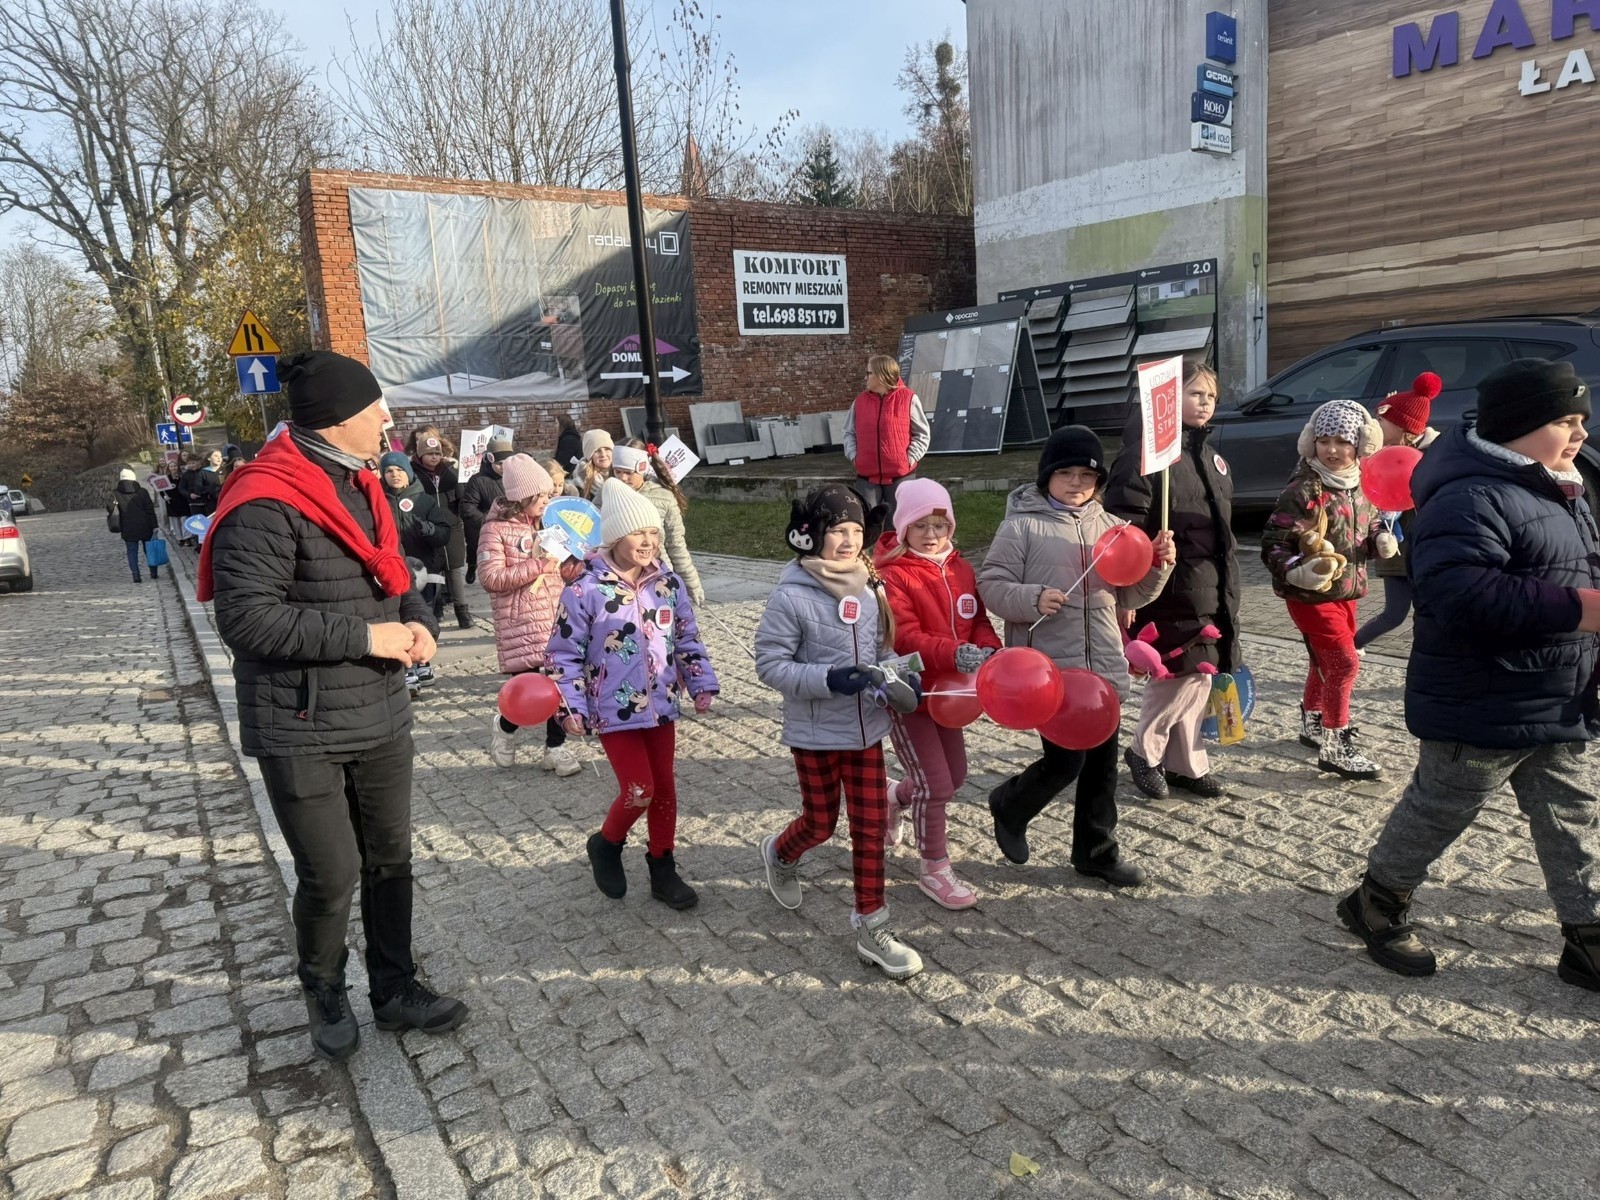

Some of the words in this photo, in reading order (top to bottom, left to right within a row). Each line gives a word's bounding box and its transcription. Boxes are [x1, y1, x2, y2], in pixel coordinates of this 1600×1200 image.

[1206, 70, 1232, 85] GERDA
[1518, 48, 1596, 96] ŁA
[1204, 99, 1225, 115] KOŁO
[744, 256, 841, 276] KOMFORT
[1193, 262, 1211, 275] 2.0
[595, 282, 627, 296] Dopasuj
[743, 281, 792, 295] REMONTY
[795, 279, 843, 296] MIESZKAŃ
[613, 298, 623, 308] do
[652, 292, 682, 304] łazienki
[753, 305, 796, 325] tel.698
[798, 308, 816, 325] 851
[818, 309, 837, 325] 179
[955, 312, 979, 320] opoczno
